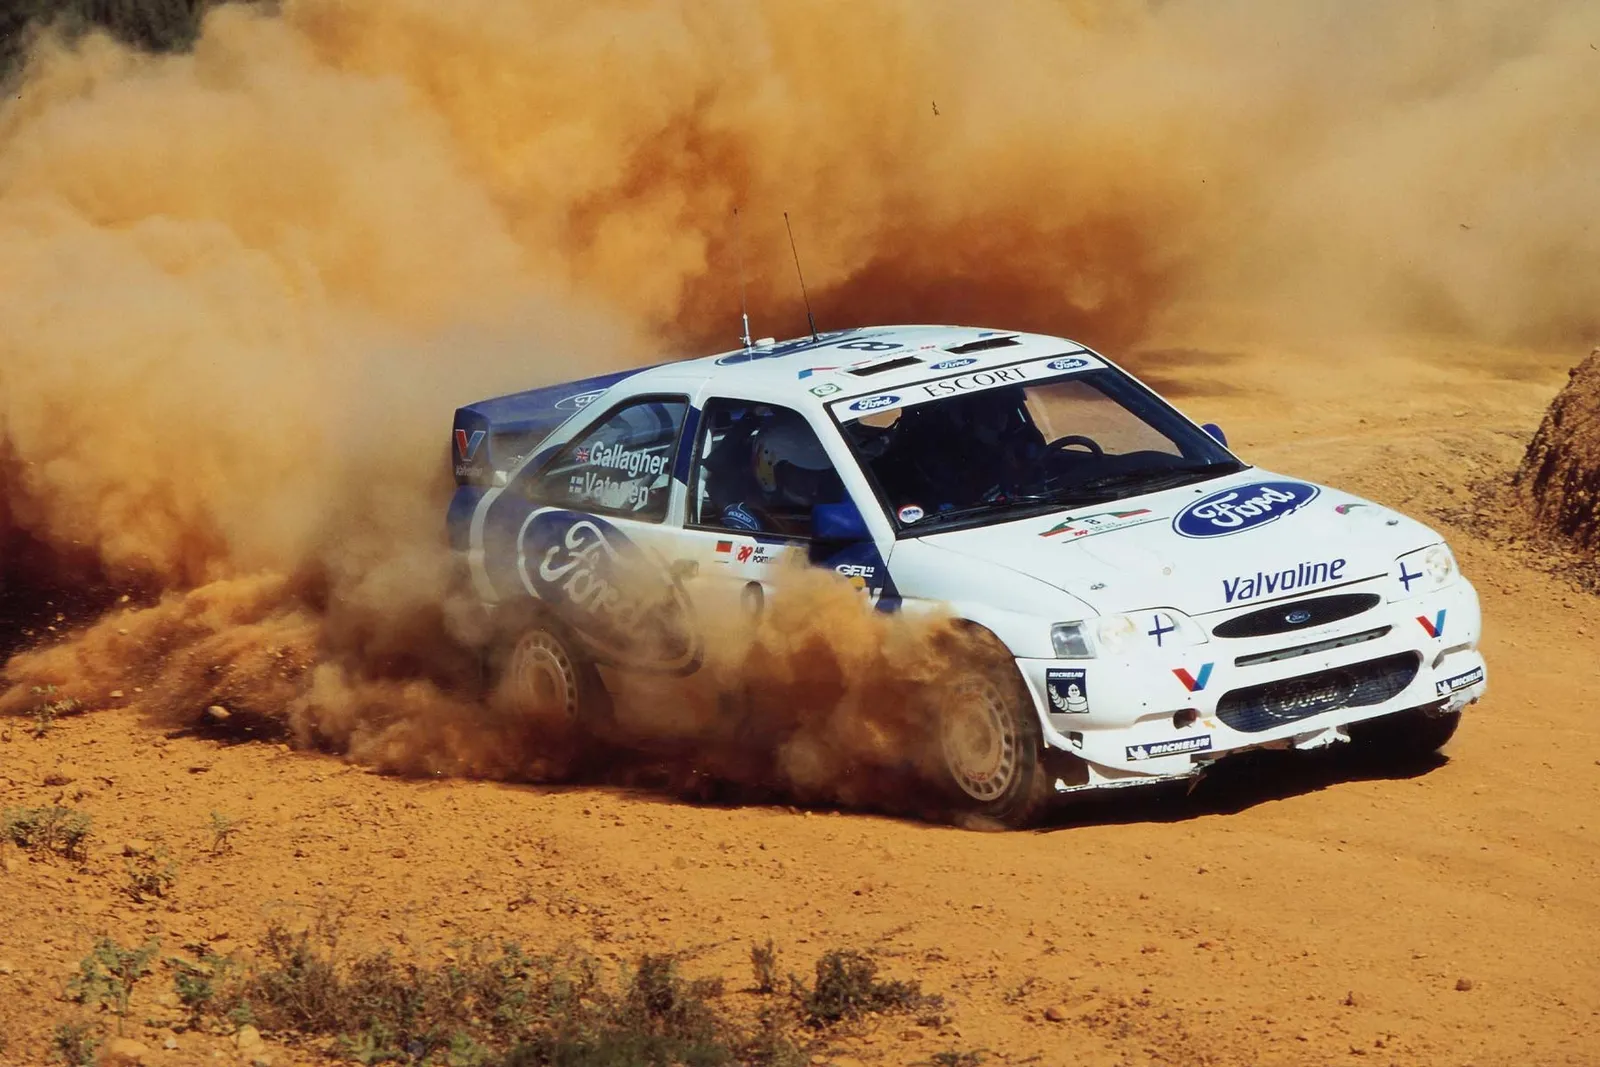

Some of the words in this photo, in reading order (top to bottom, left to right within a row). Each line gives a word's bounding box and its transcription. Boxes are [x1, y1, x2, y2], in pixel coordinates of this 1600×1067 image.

[938, 358, 970, 369] Ford
[1053, 358, 1083, 370] Ford
[922, 366, 1028, 398] ESCORT
[858, 396, 893, 410] Ford
[589, 440, 669, 478] Gallagher
[585, 471, 649, 504] Vaten
[1191, 485, 1298, 527] Ford
[754, 546, 765, 555] AIR
[1221, 558, 1347, 604] Valvoline
[1048, 671, 1084, 679] MICHELIN
[1149, 737, 1210, 755] MICHELIN
